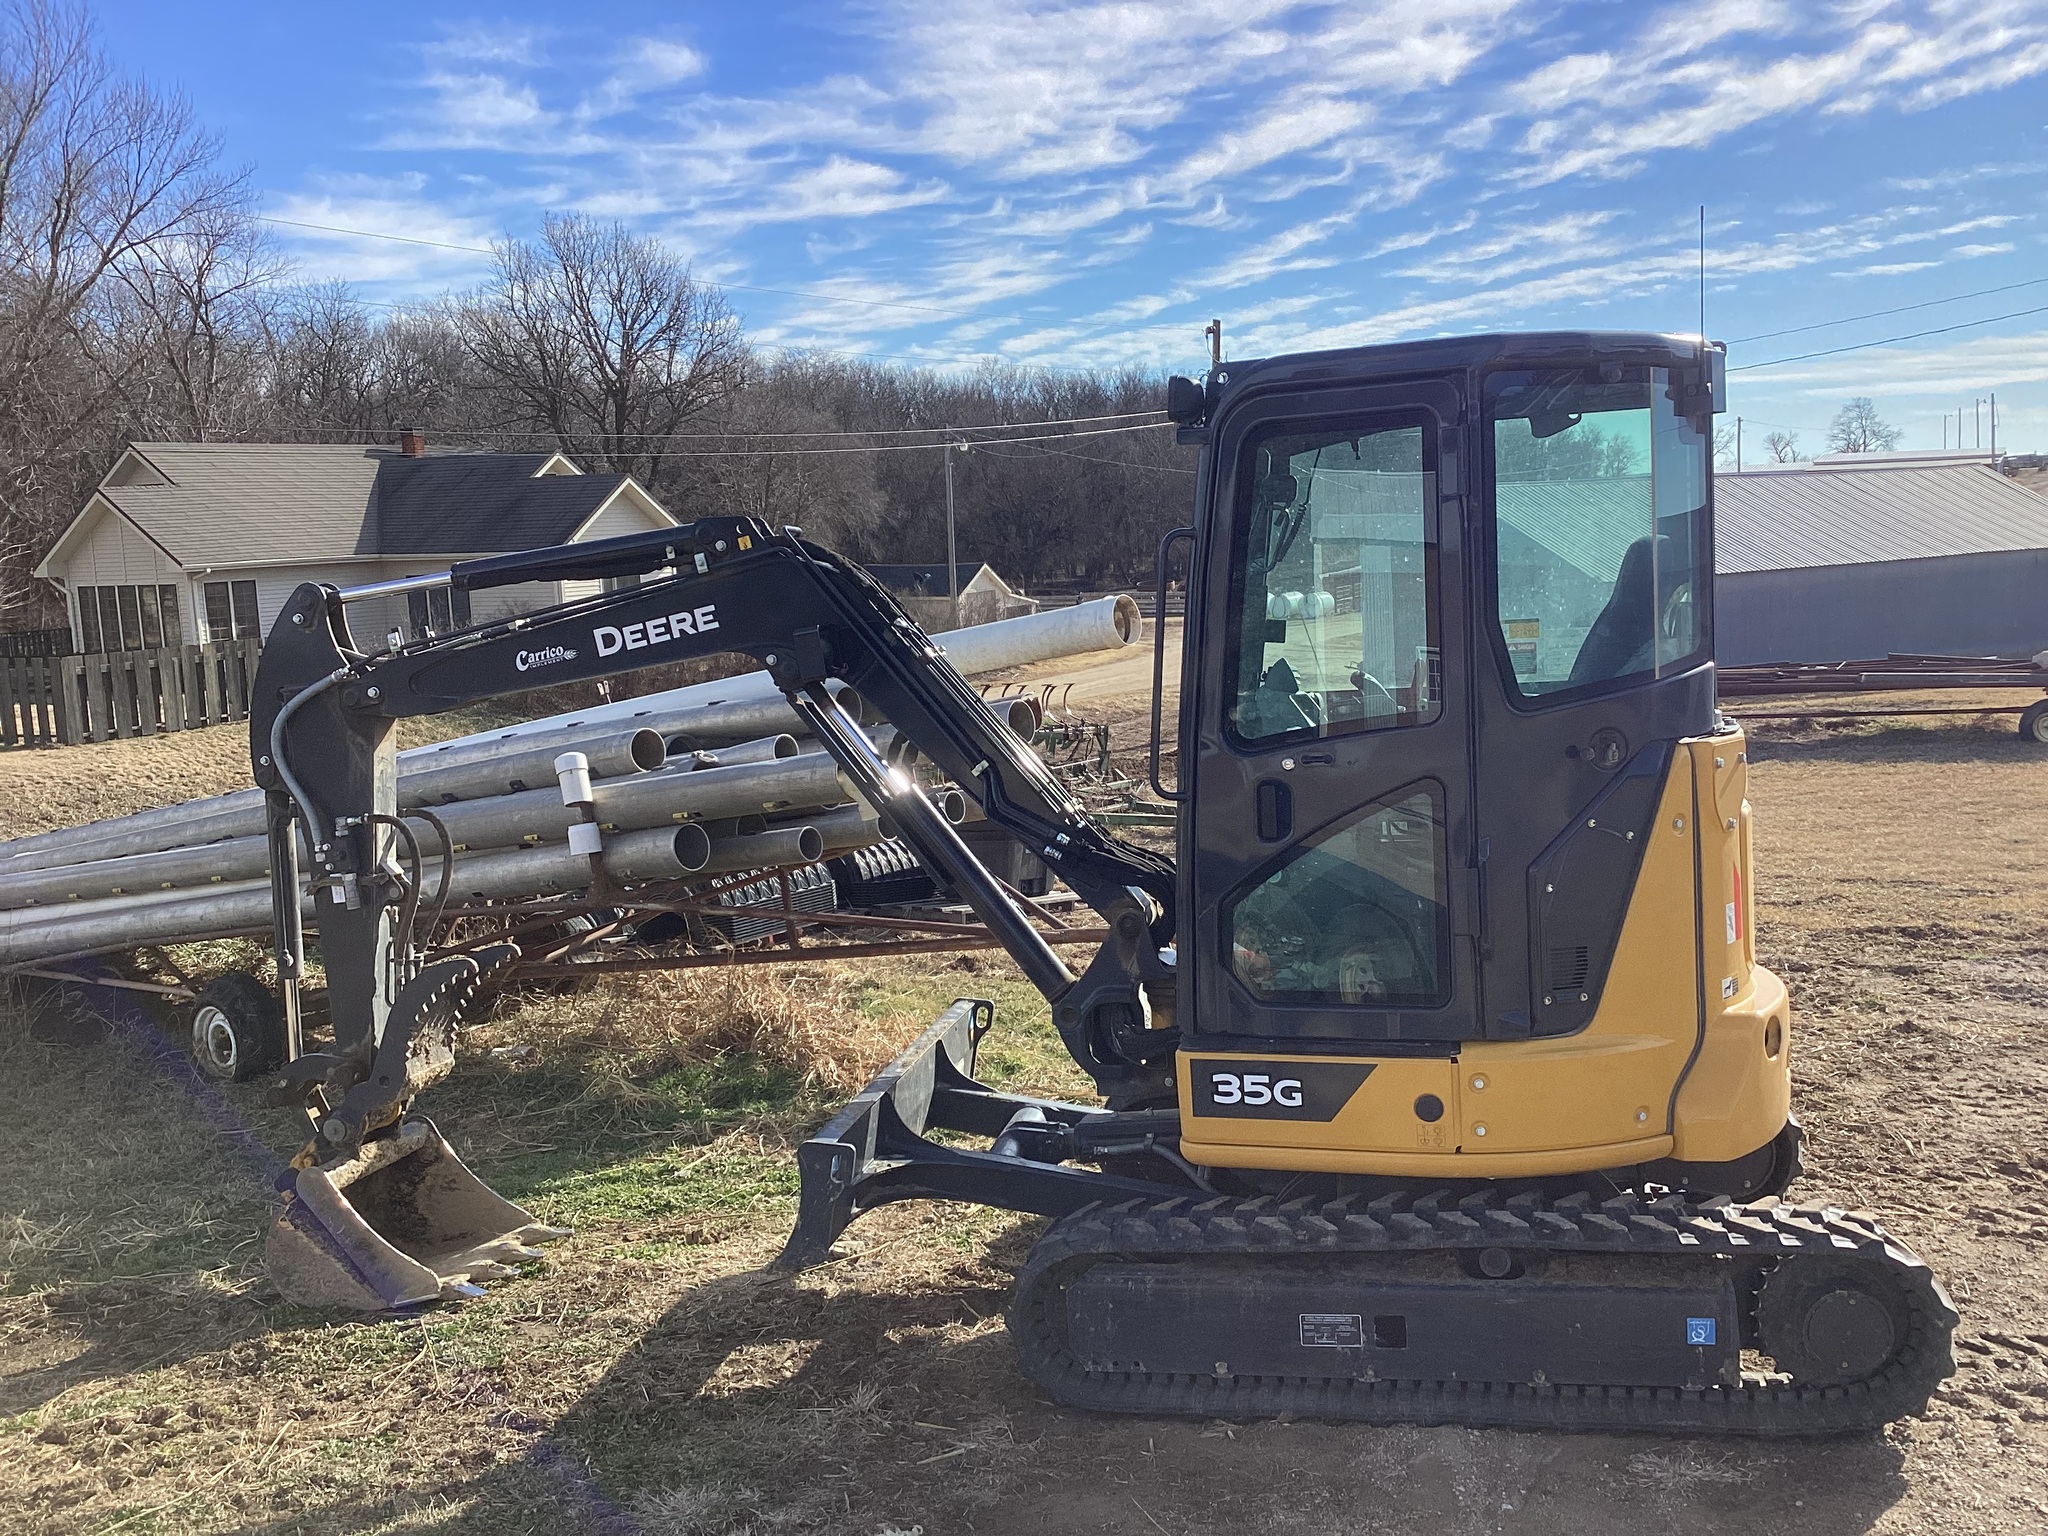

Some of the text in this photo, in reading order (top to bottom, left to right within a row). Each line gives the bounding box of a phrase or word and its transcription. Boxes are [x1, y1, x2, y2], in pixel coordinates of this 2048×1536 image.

[593, 604, 719, 657] DEERE
[515, 645, 564, 671] Carrico
[1212, 1073, 1303, 1107] 35G
